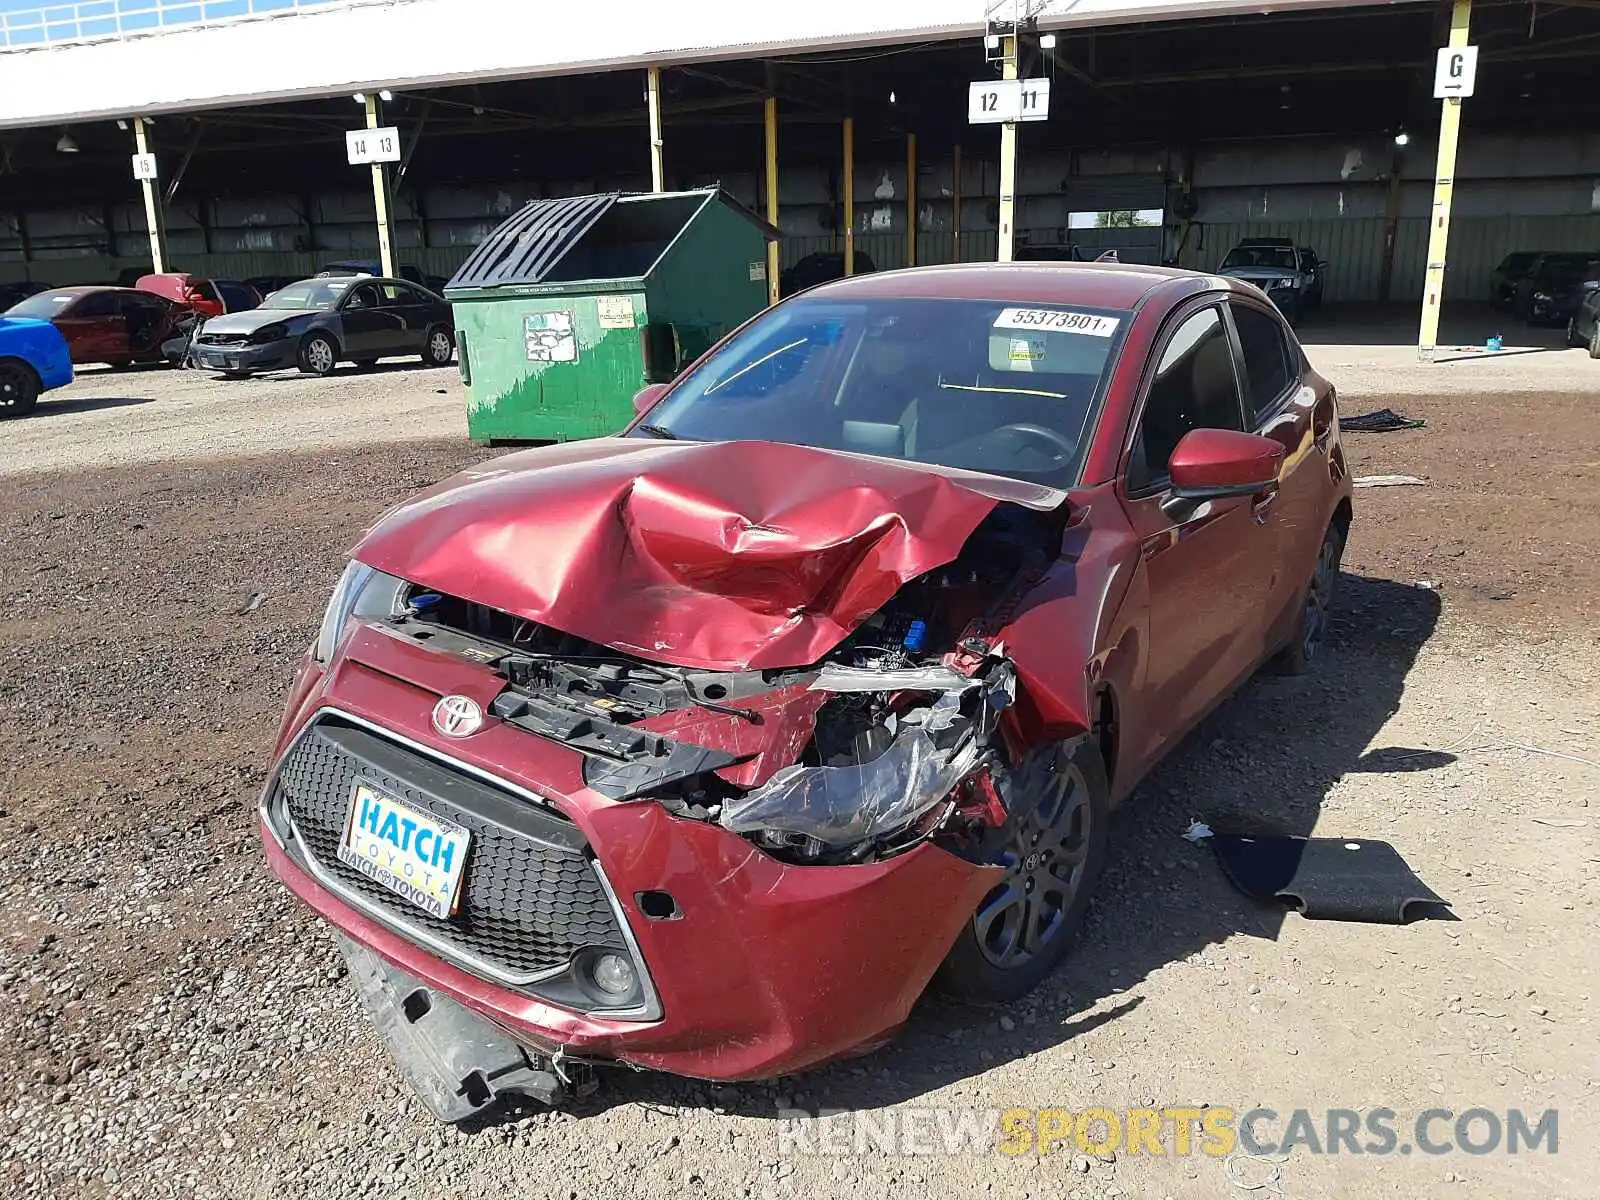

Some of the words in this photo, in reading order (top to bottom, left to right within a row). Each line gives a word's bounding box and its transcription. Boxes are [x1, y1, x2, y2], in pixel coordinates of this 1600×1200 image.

[1450, 54, 1463, 77] G
[980, 93, 998, 111] 12
[1021, 91, 1036, 109] 11
[355, 140, 366, 155] 14
[380, 137, 392, 152] 13
[140, 160, 150, 172] 15
[1012, 310, 1103, 331] 55373801
[359, 798, 456, 874] HATCH
[355, 833, 449, 897] TOYOTA
[340, 846, 378, 878] HATCH
[392, 875, 442, 917] TOYOTA
